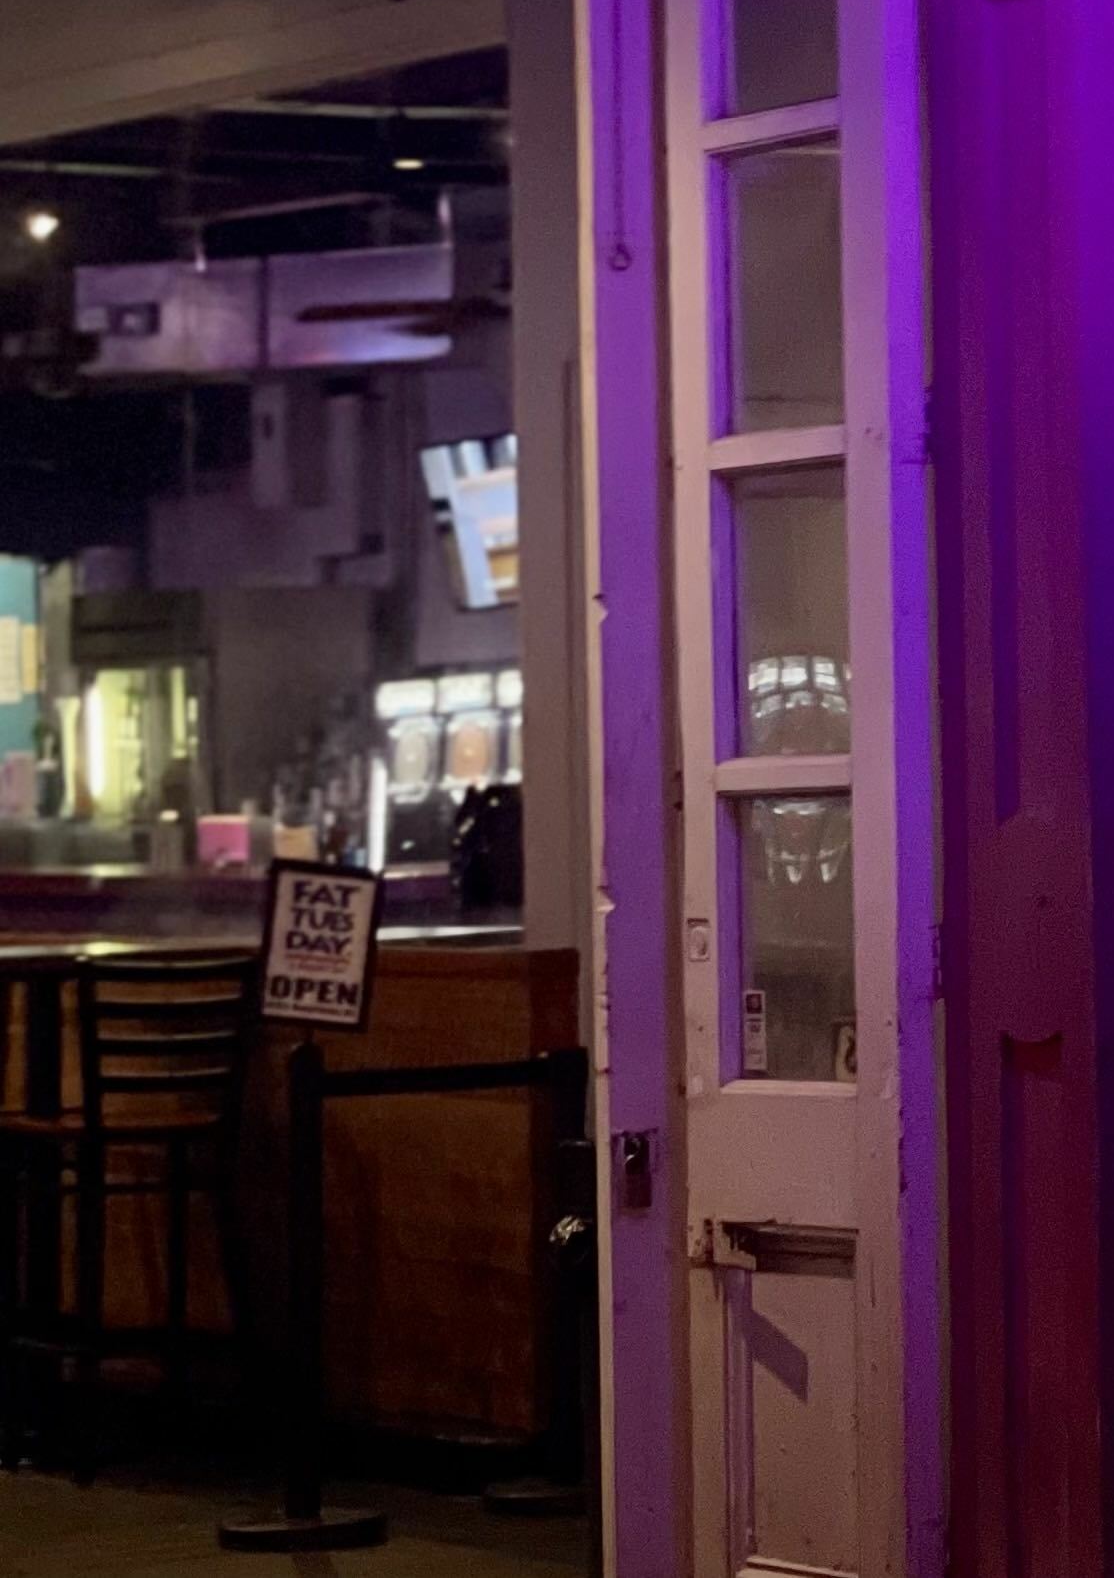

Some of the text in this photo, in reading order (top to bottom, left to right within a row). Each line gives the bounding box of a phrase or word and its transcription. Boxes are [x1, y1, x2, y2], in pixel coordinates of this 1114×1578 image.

[293, 880, 361, 908] FAT
[286, 930, 351, 955] DAY
[270, 975, 359, 1005] OPEN
